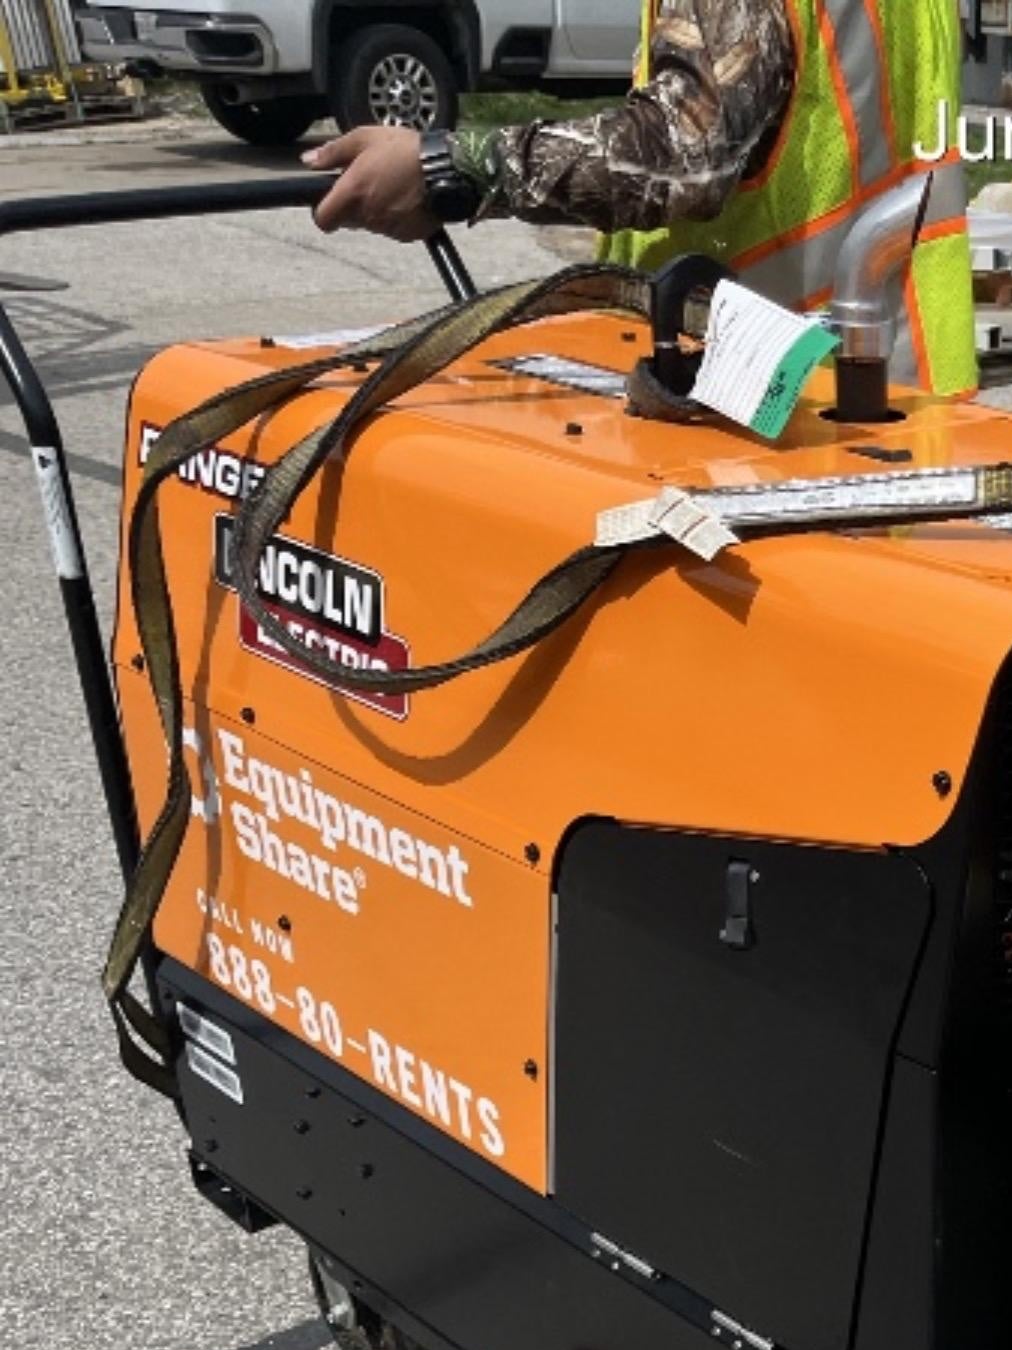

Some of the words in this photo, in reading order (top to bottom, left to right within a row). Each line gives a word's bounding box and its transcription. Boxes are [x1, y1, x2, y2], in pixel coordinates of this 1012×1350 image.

[217, 729, 475, 908] Equipment
[196, 887, 244, 934] CALL
[249, 917, 295, 964] NOW
[206, 931, 506, 1157] 888-80-RENTS
